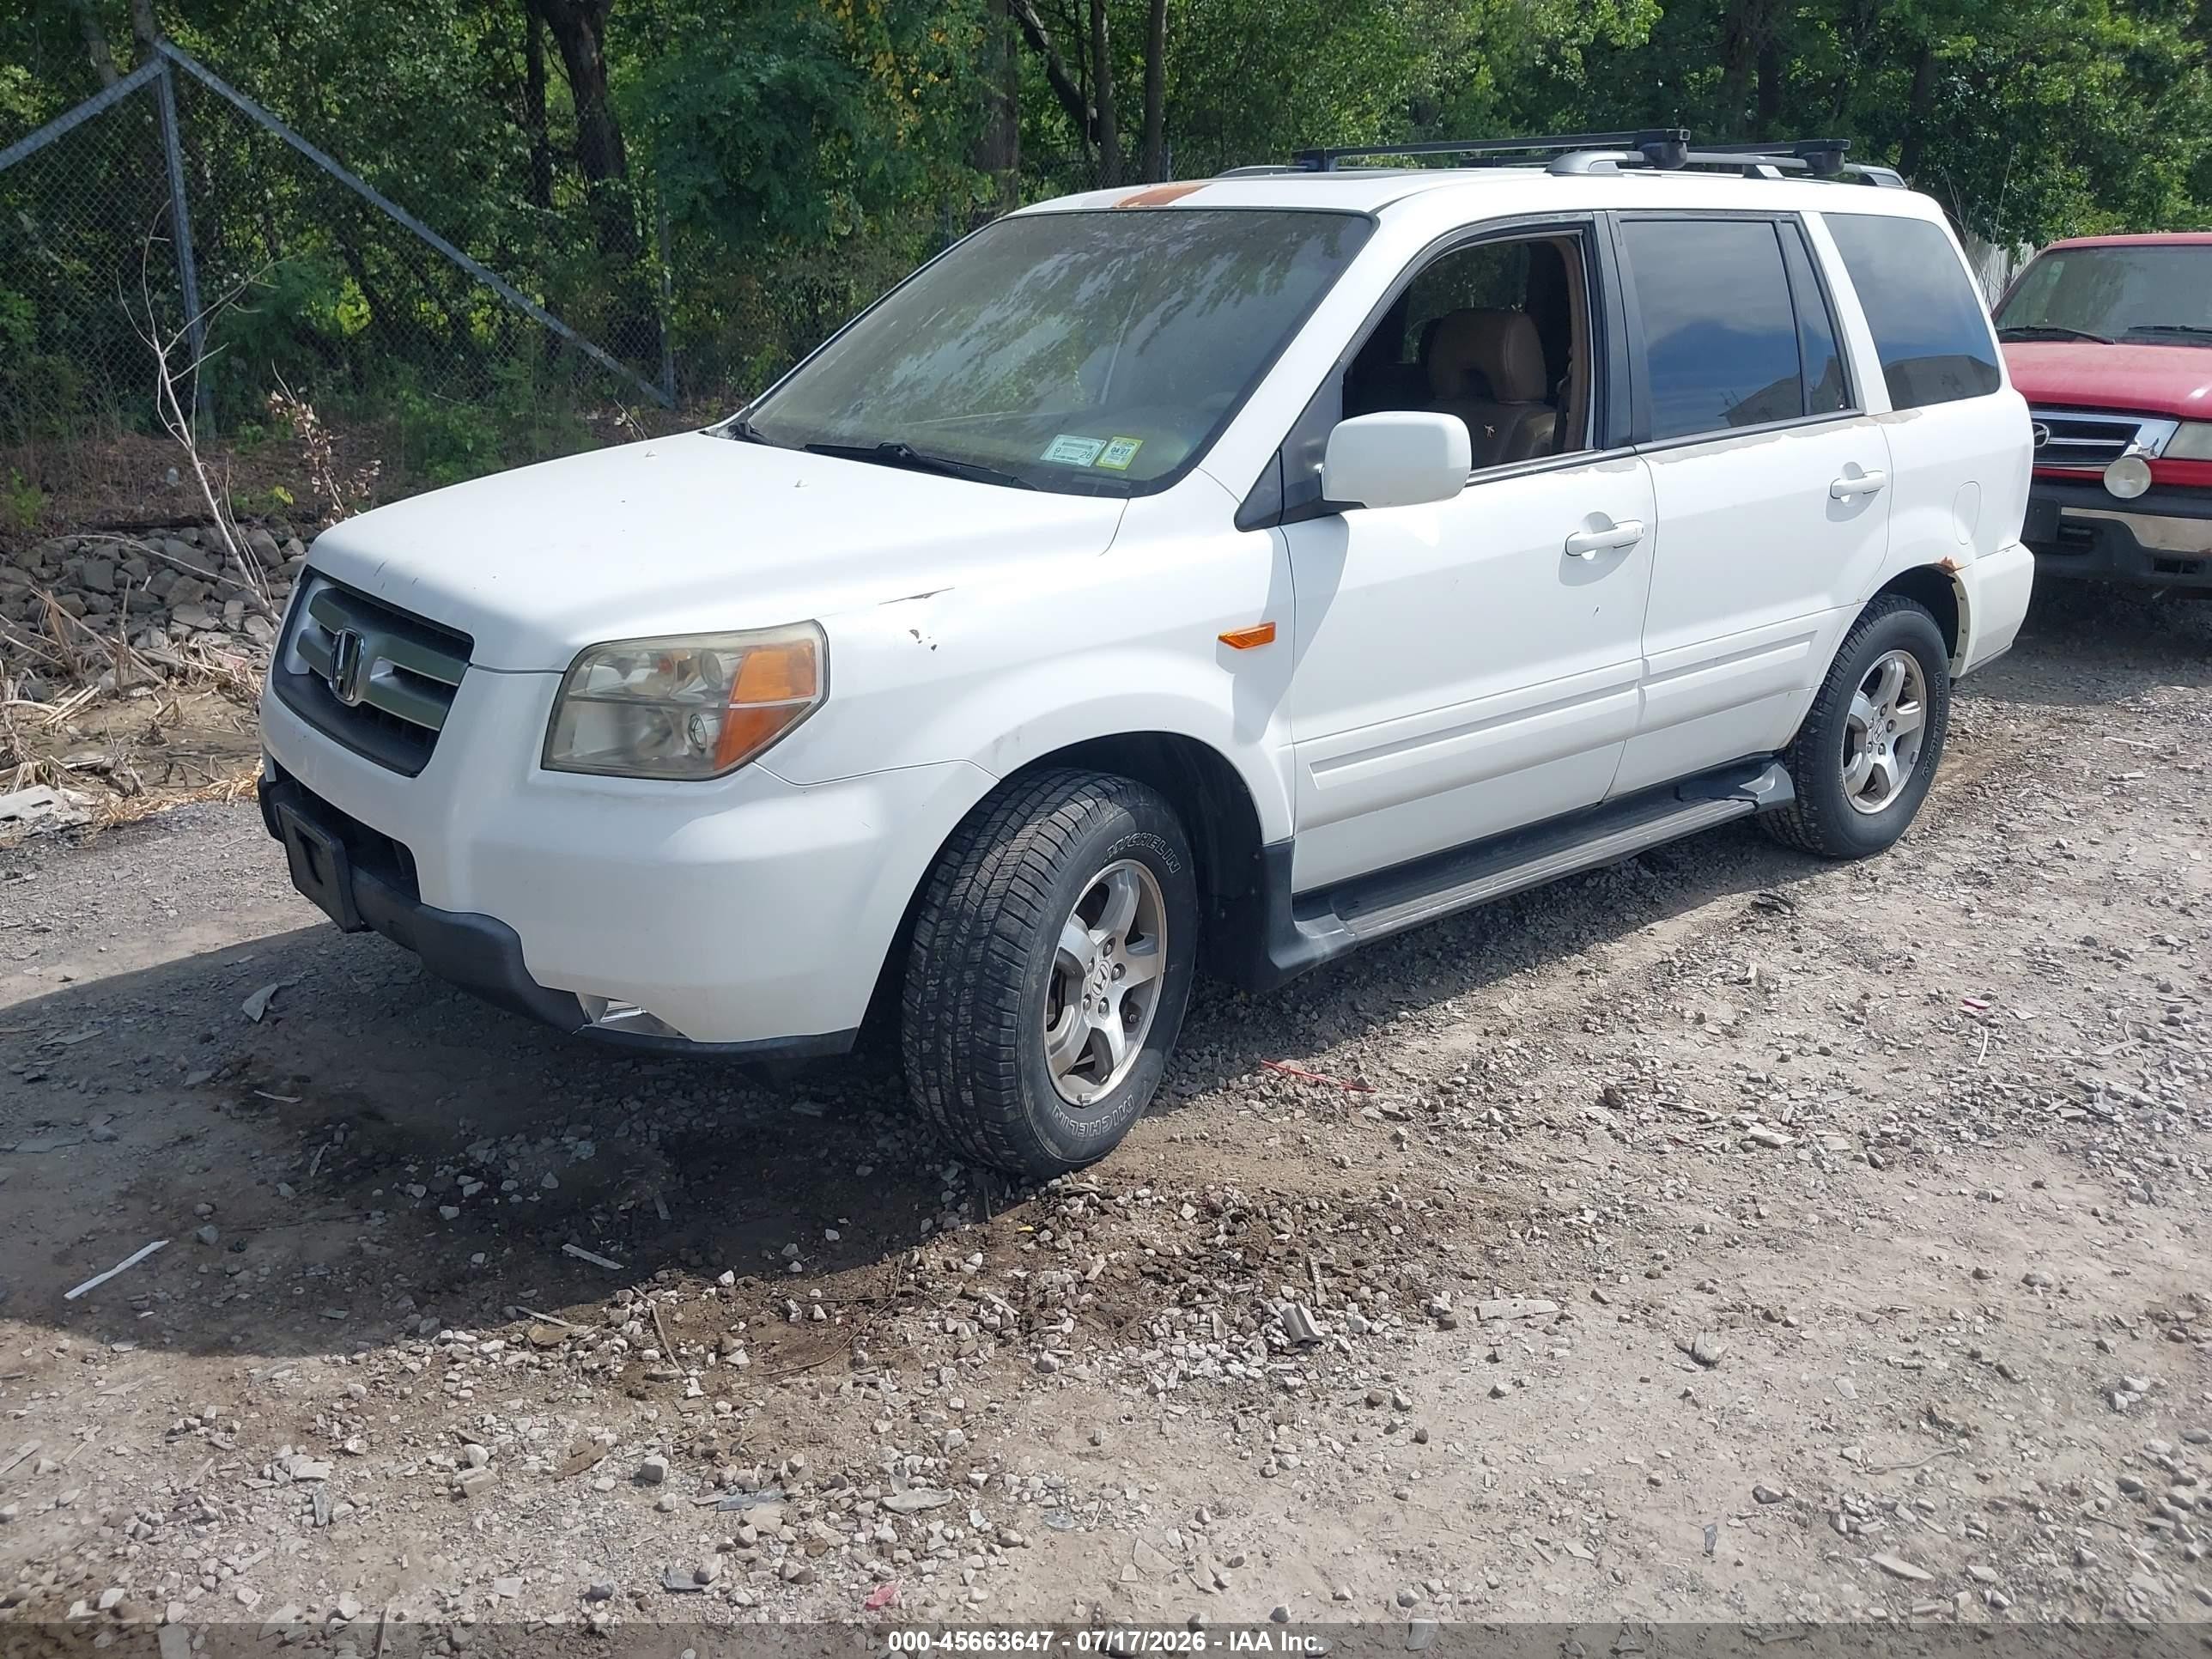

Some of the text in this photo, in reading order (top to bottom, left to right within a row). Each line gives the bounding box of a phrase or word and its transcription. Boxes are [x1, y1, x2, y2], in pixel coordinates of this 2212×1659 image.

[1079, 451, 1092, 459] 26
[1103, 832, 1182, 873] MICHELIN
[1052, 1094, 1134, 1139] MICHELIN
